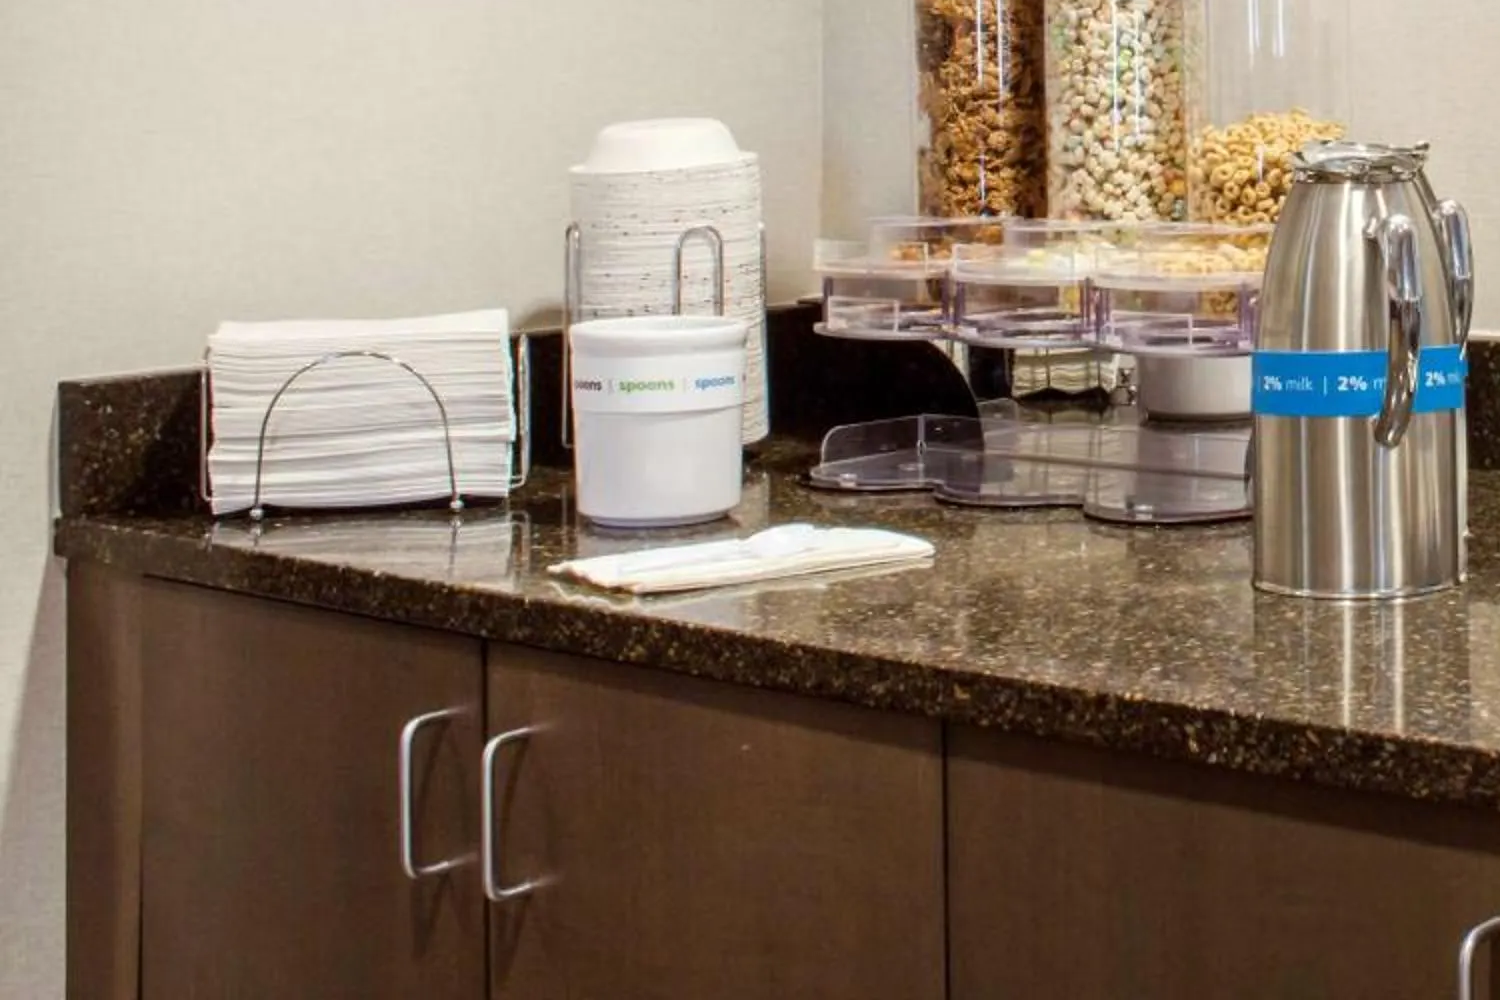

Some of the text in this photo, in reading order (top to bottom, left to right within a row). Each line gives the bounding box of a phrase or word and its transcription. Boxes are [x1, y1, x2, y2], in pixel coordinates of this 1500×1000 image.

[619, 379, 674, 393] spoons
[1285, 374, 1313, 391] milk
[1337, 375, 1368, 391] 2%
